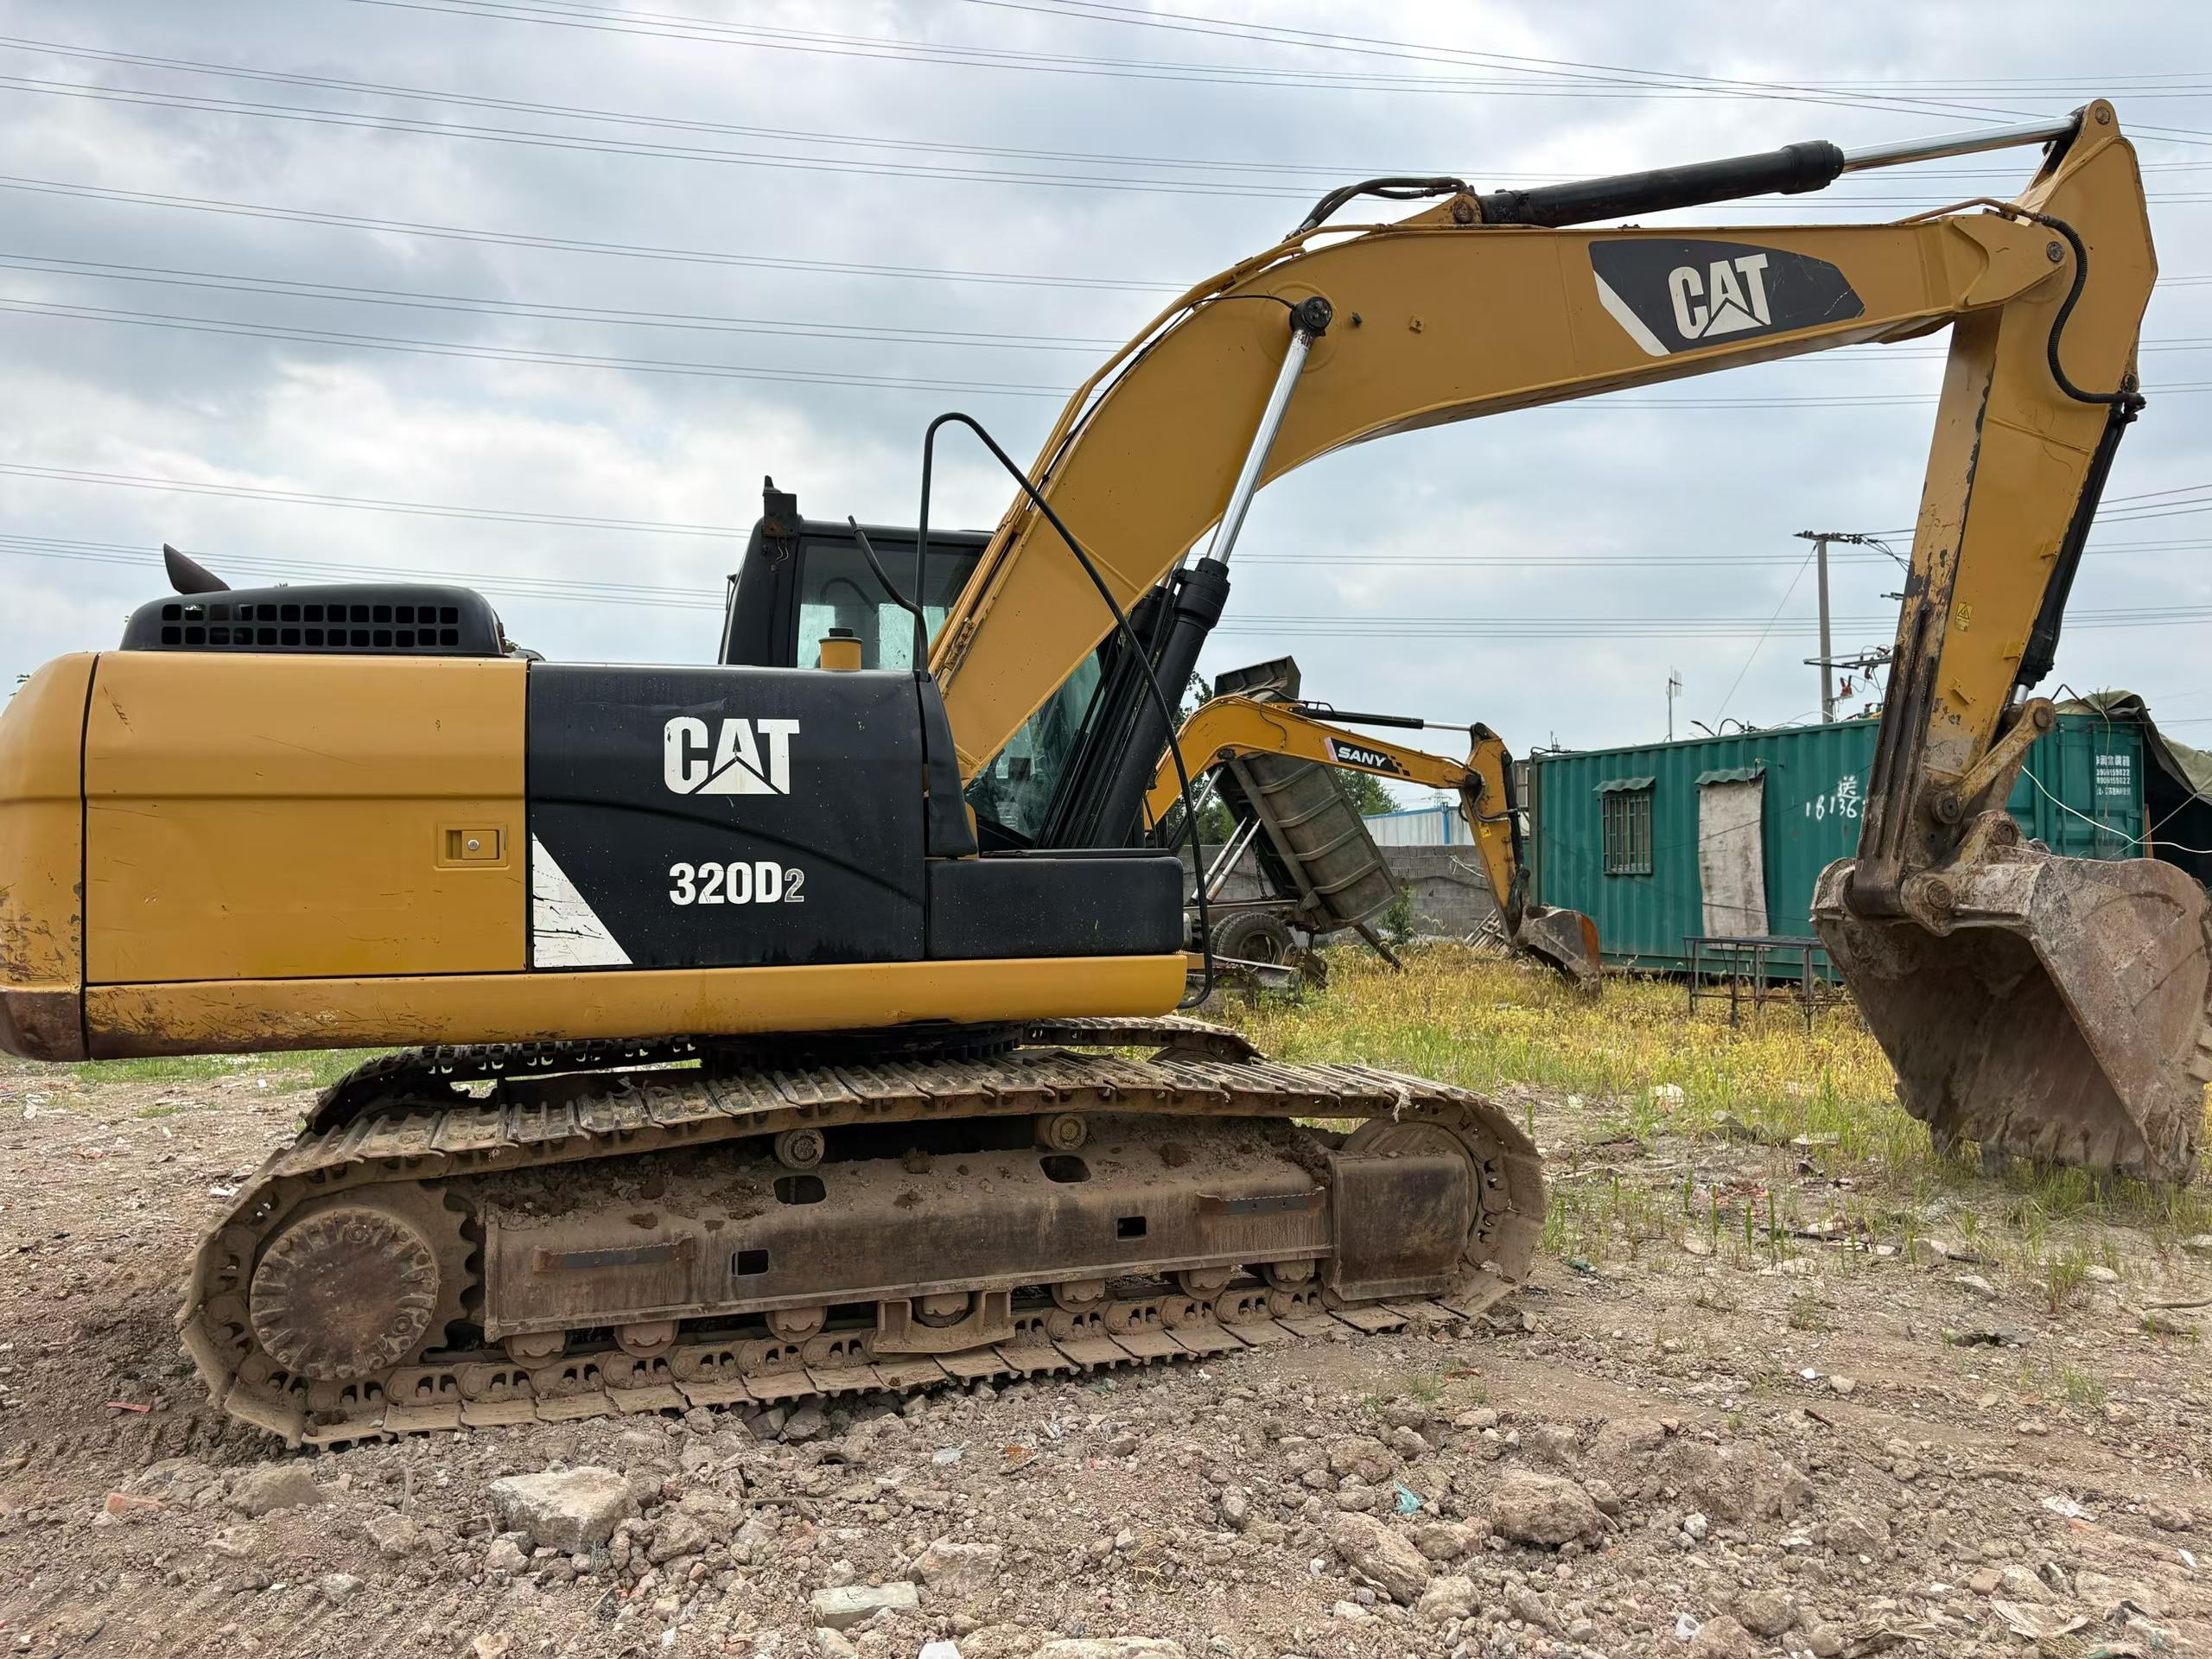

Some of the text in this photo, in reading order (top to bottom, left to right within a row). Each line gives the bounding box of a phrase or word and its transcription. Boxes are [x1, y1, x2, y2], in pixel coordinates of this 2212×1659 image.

[1669, 253, 1771, 340] CAT
[664, 716, 800, 795] CAT
[1338, 747, 1388, 767] SANY
[1806, 794, 1866, 820] 18136
